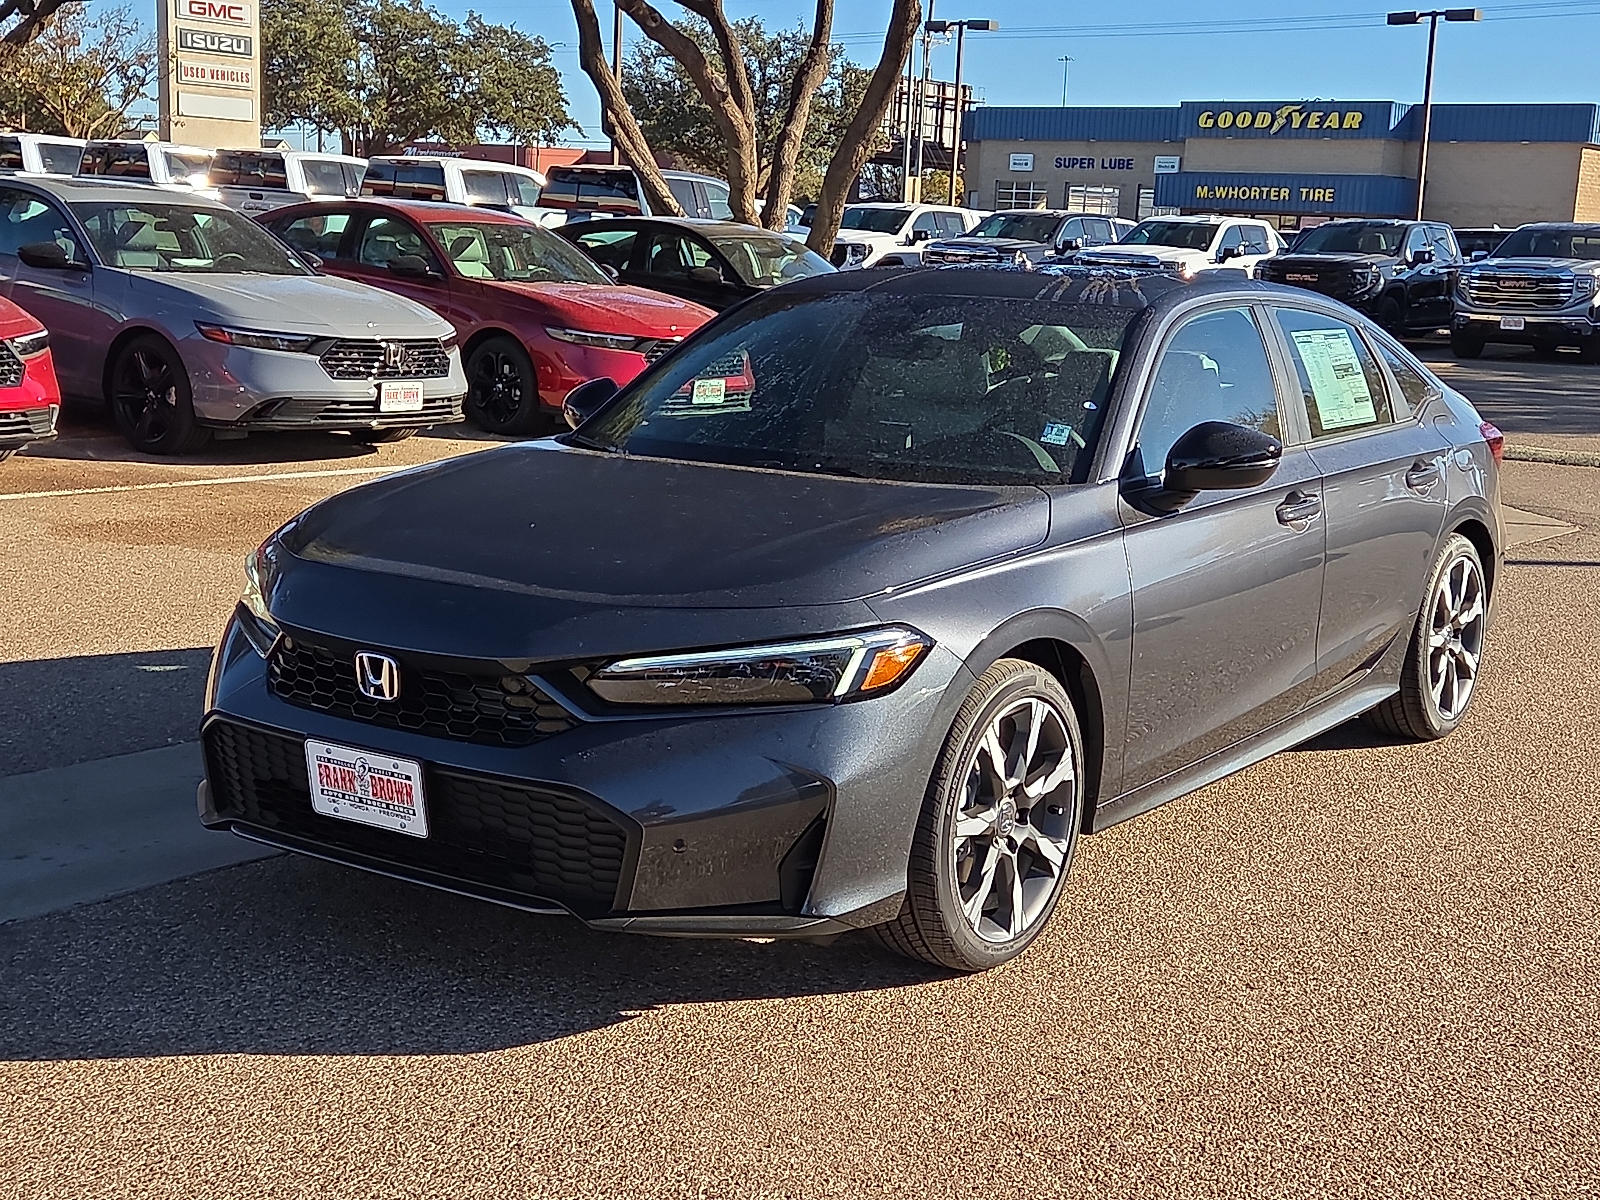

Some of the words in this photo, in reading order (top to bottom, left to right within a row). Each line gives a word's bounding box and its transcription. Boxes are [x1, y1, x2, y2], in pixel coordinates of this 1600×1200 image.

[189, 0, 243, 21] GMC
[187, 32, 245, 53] ISUZU
[183, 66, 206, 79] USED
[210, 69, 250, 83] VEHICLES
[1054, 157, 1096, 169] SUPER
[1101, 158, 1135, 170] LUBE
[1196, 185, 1291, 201] McWHORTER
[1300, 188, 1335, 202] TIRE
[317, 763, 357, 794] FRANK
[369, 775, 415, 807] BROWN
